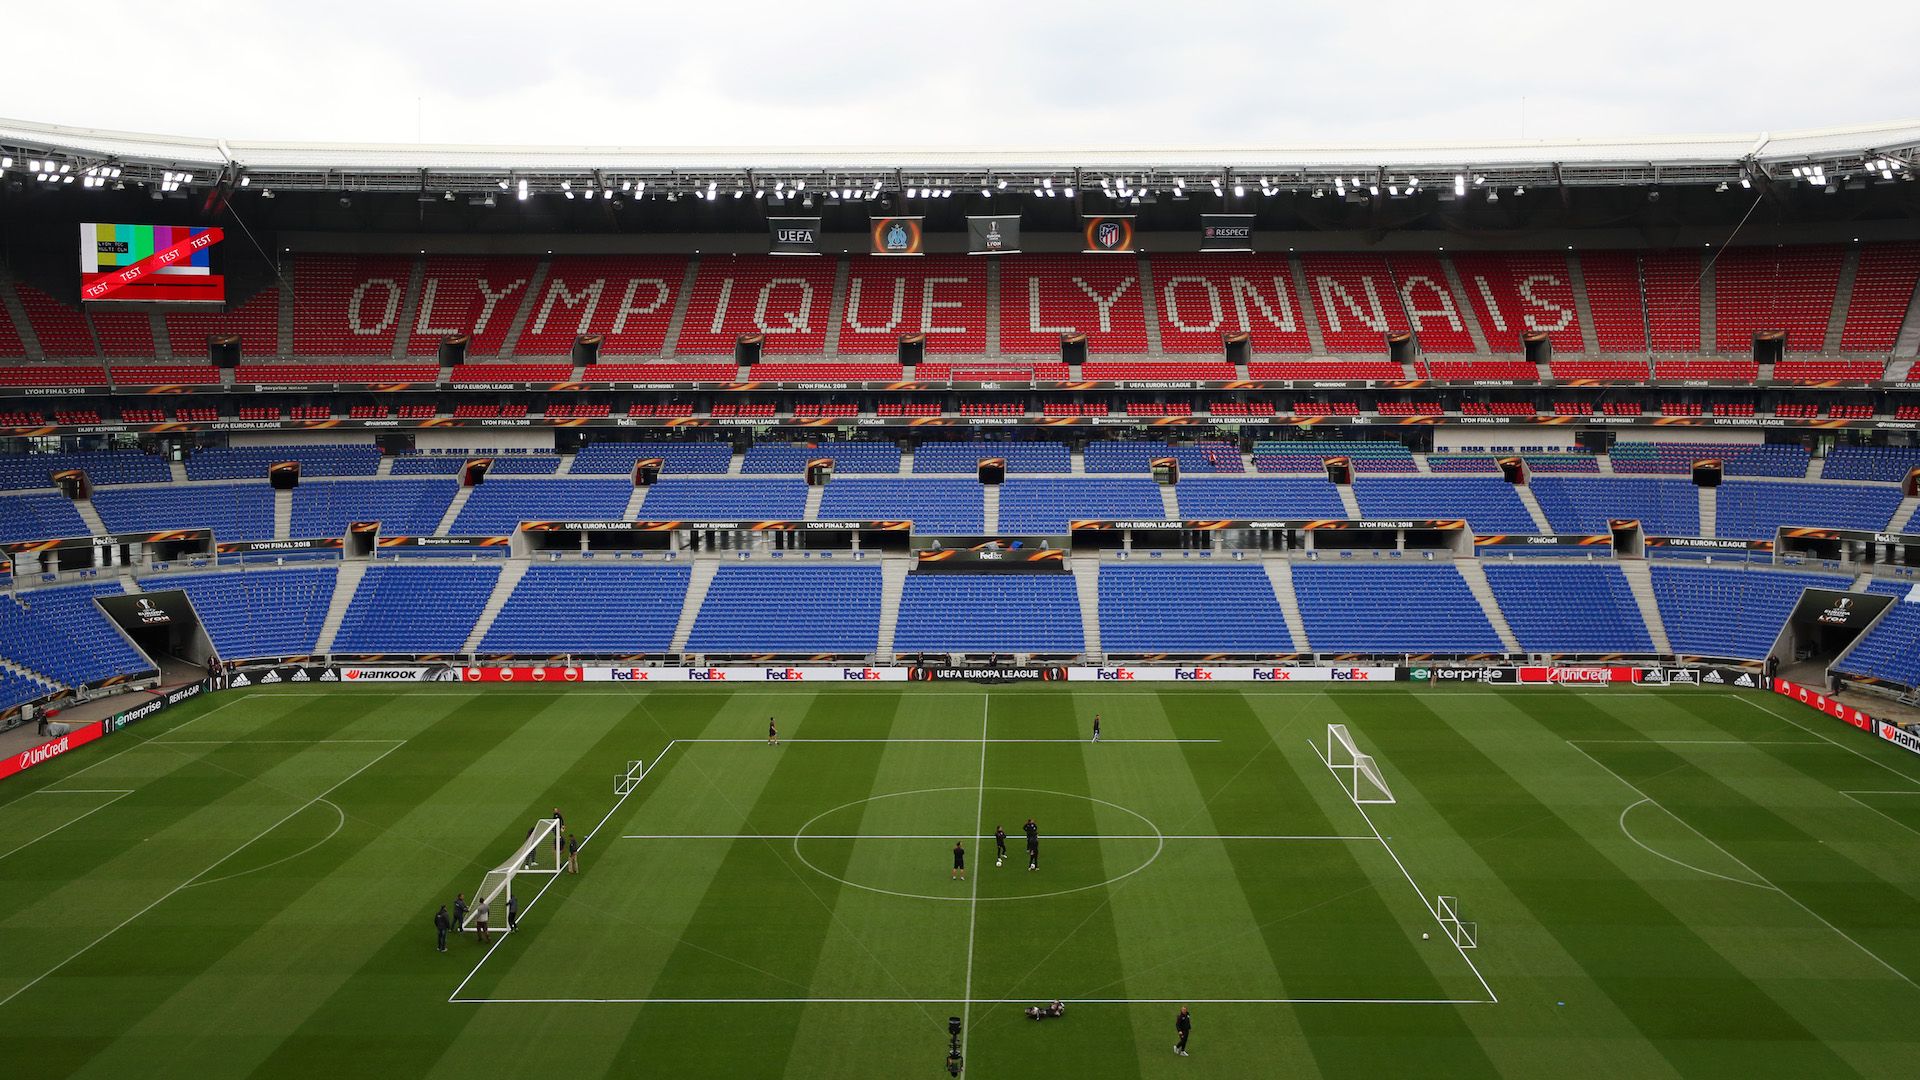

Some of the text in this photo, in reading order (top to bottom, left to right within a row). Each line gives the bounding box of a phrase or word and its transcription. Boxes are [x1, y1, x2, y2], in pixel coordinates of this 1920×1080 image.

[779, 230, 813, 242] UEFA
[1216, 229, 1249, 237] RESPECT
[190, 234, 211, 248] TEST
[159, 249, 180, 263] TEST
[120, 267, 142, 281] TEST
[87, 282, 108, 296] TEST
[347, 275, 1574, 335] OLYMPIQUE LYONNAIS
[93, 537, 118, 546] FedEx
[1533, 536, 1558, 544] UniCredit
[1690, 539, 1718, 547] EUROPA
[1718, 540, 1747, 548] LEAGUE
[979, 551, 1003, 560] FedEx
[1818, 615, 1847, 623] LYON
[611, 668, 648, 680] FedEx
[689, 668, 725, 680] FedEx
[766, 668, 803, 680] FedEx
[844, 668, 880, 680] FedEx
[937, 670, 1039, 678] UEFA EUROPA LEAGUE
[1097, 668, 1134, 680] FedEx
[1175, 668, 1212, 680] FedEx
[1253, 668, 1290, 680] FedEx
[1331, 668, 1368, 680] FedEx
[1734, 680, 1755, 688] adidas
[169, 684, 200, 704] RENT-A-CAR
[116, 699, 161, 725] enterprise
[30, 736, 69, 764] UniCredit
